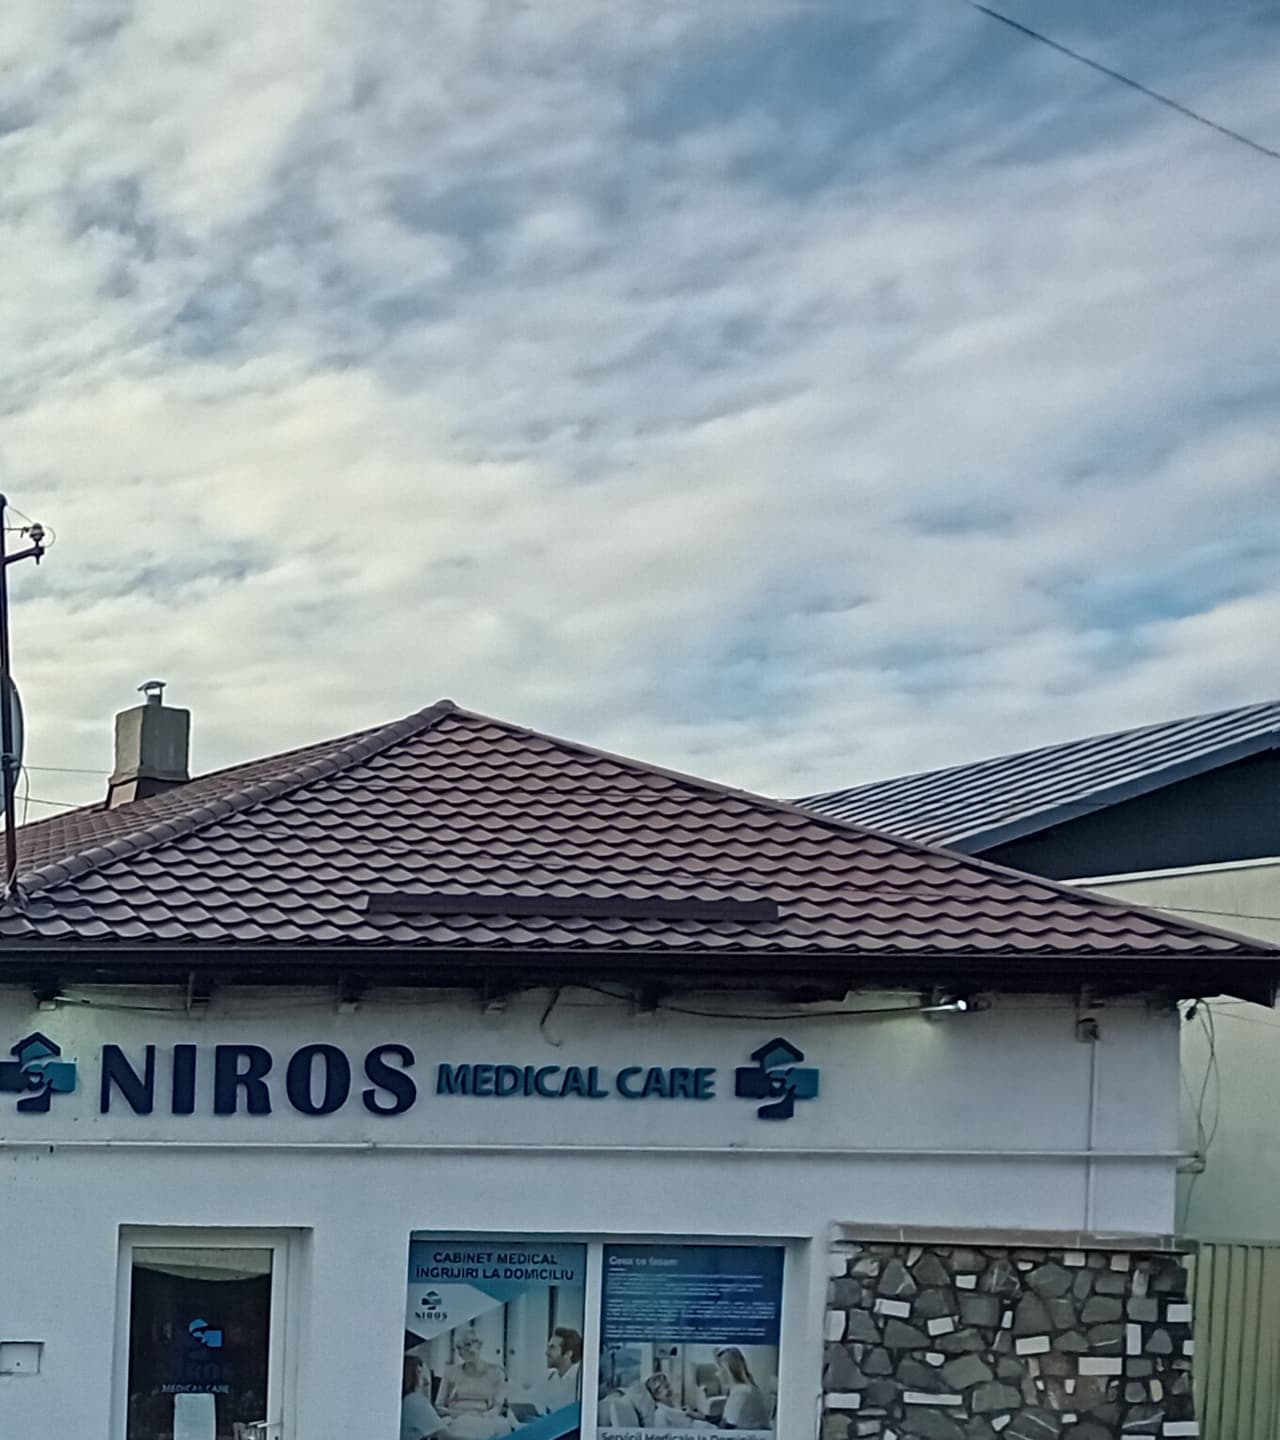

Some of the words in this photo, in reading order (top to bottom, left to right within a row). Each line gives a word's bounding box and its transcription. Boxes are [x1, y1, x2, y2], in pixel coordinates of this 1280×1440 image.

[100, 1044, 417, 1115] NIROS
[436, 1063, 609, 1098] MEDICAL
[616, 1066, 716, 1099] CARE
[433, 1252, 493, 1264] CABINET
[497, 1253, 558, 1265] MEDICAL
[483, 1268, 500, 1279] LA
[504, 1268, 574, 1281] DOMICILIU
